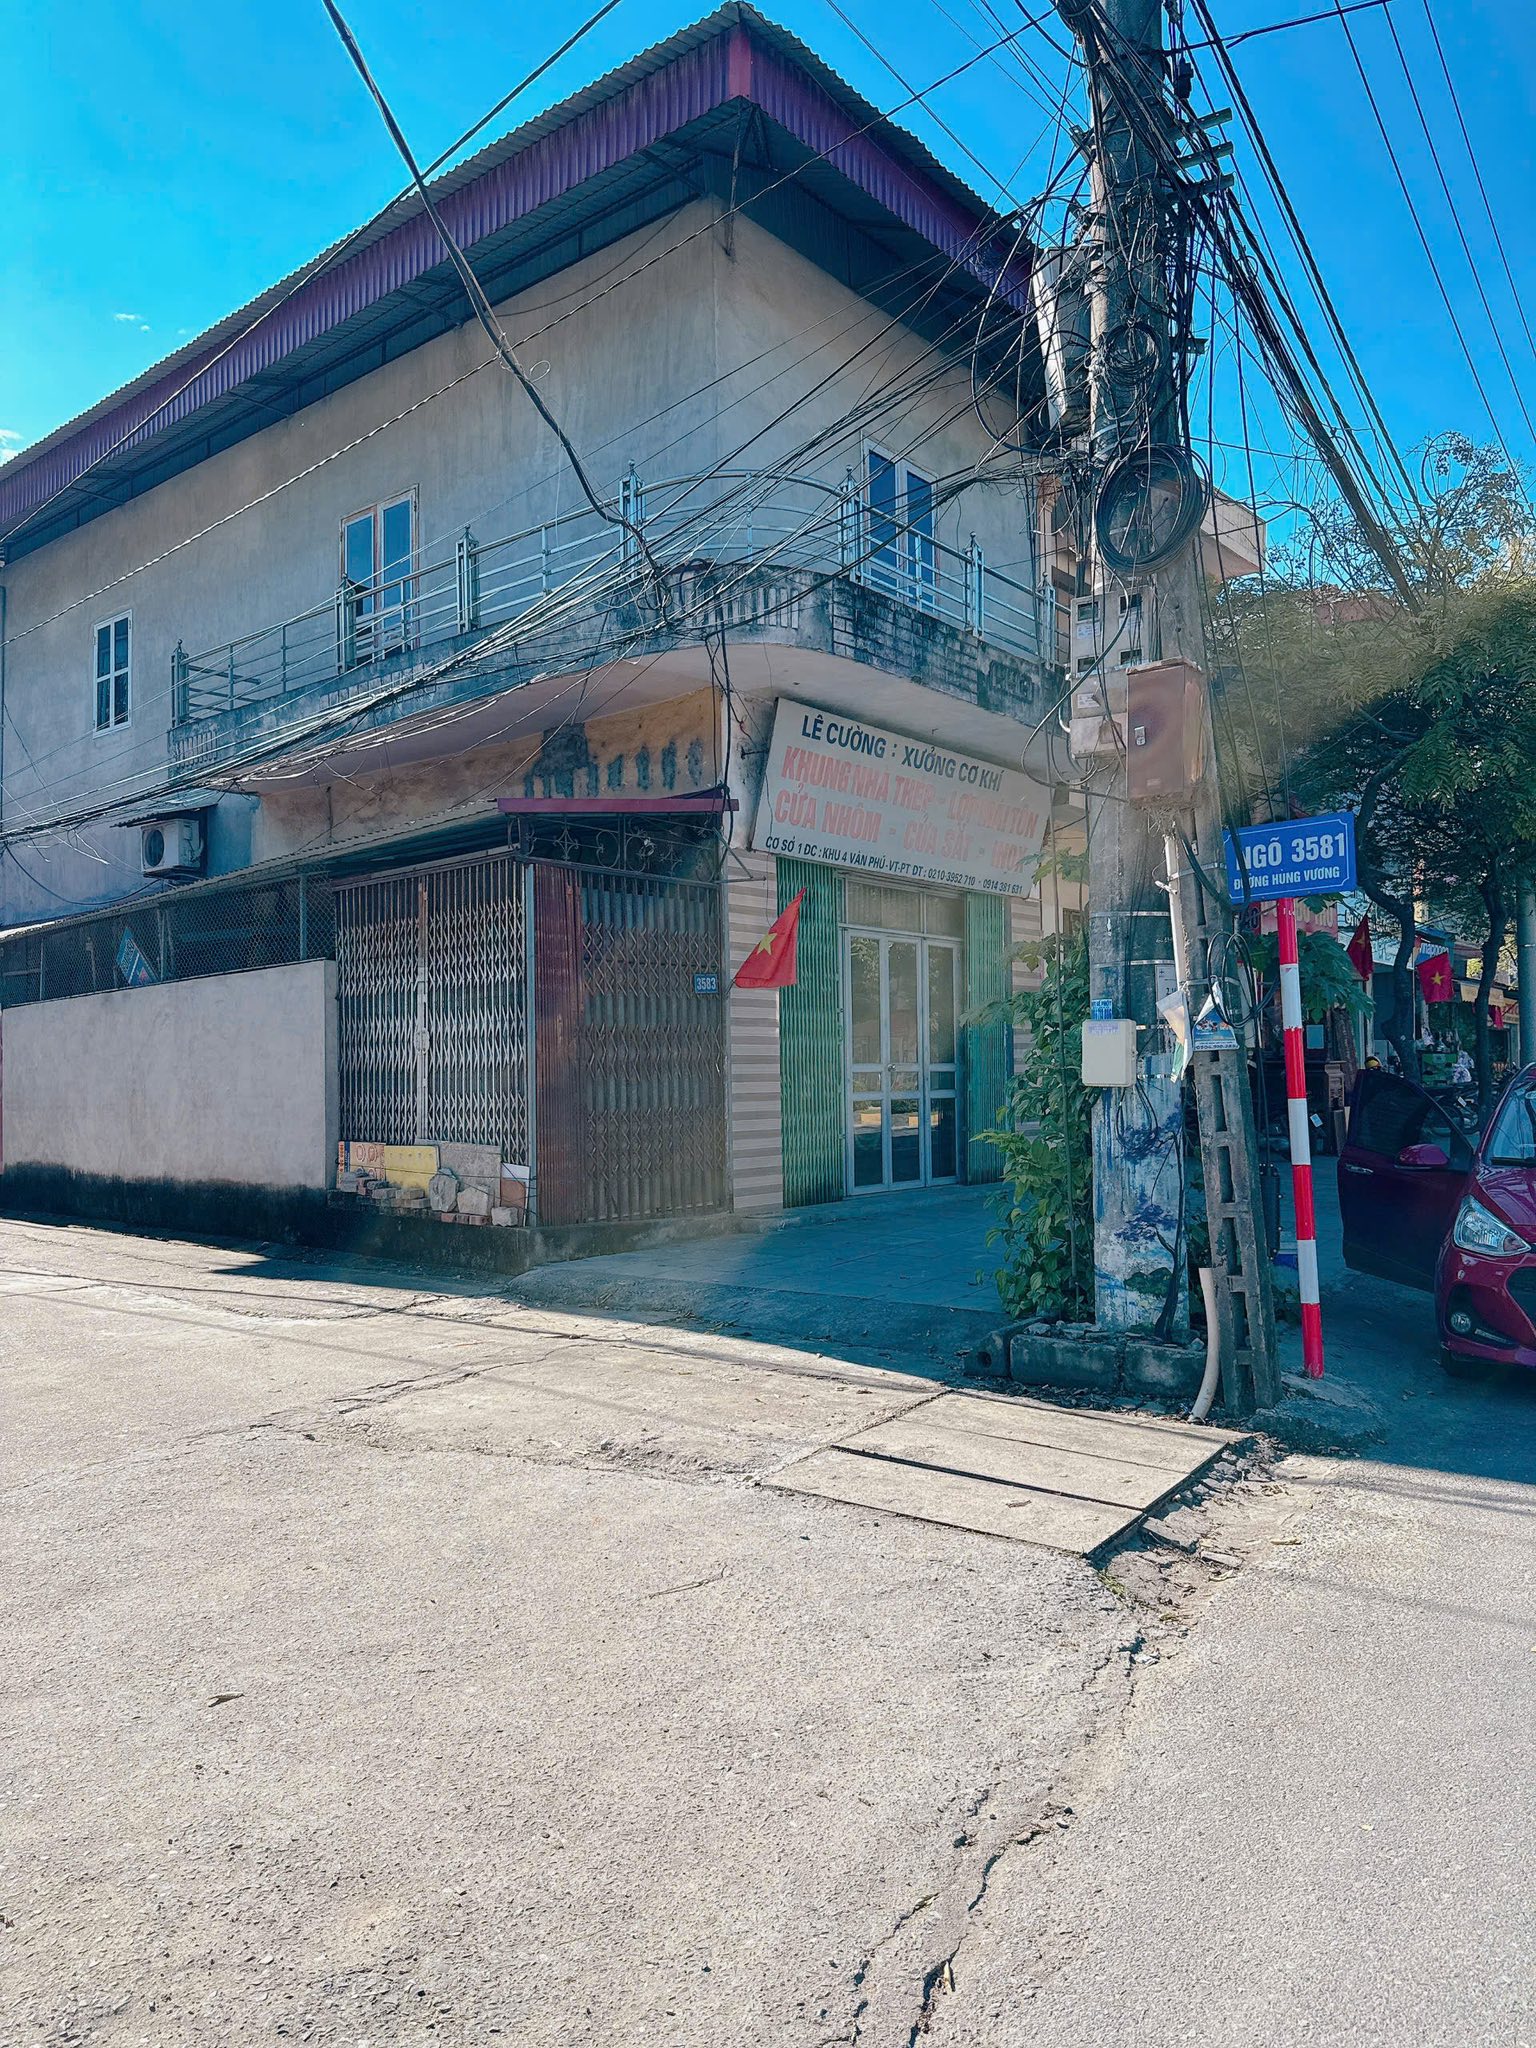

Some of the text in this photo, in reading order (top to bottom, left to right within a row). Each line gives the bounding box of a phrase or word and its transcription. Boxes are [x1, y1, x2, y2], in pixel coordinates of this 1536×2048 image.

[802, 714, 823, 740] LÊ
[826, 722, 887, 758] CƯỜNG
[901, 746, 956, 778] XƯỞNG
[958, 763, 979, 784] CƠ
[978, 770, 1005, 792] KHÍ
[781, 745, 852, 793] KHUNG
[775, 783, 817, 830] CỬA
[821, 801, 882, 842] NHÔM
[765, 835, 780, 849] CƠ
[797, 844, 802, 854] 1
[822, 847, 841, 861] KHU
[842, 852, 847, 862] 4
[1291, 832, 1345, 862] 3581
[1303, 866, 1340, 881] VƯƠNG
[697, 977, 717, 990] 3583
